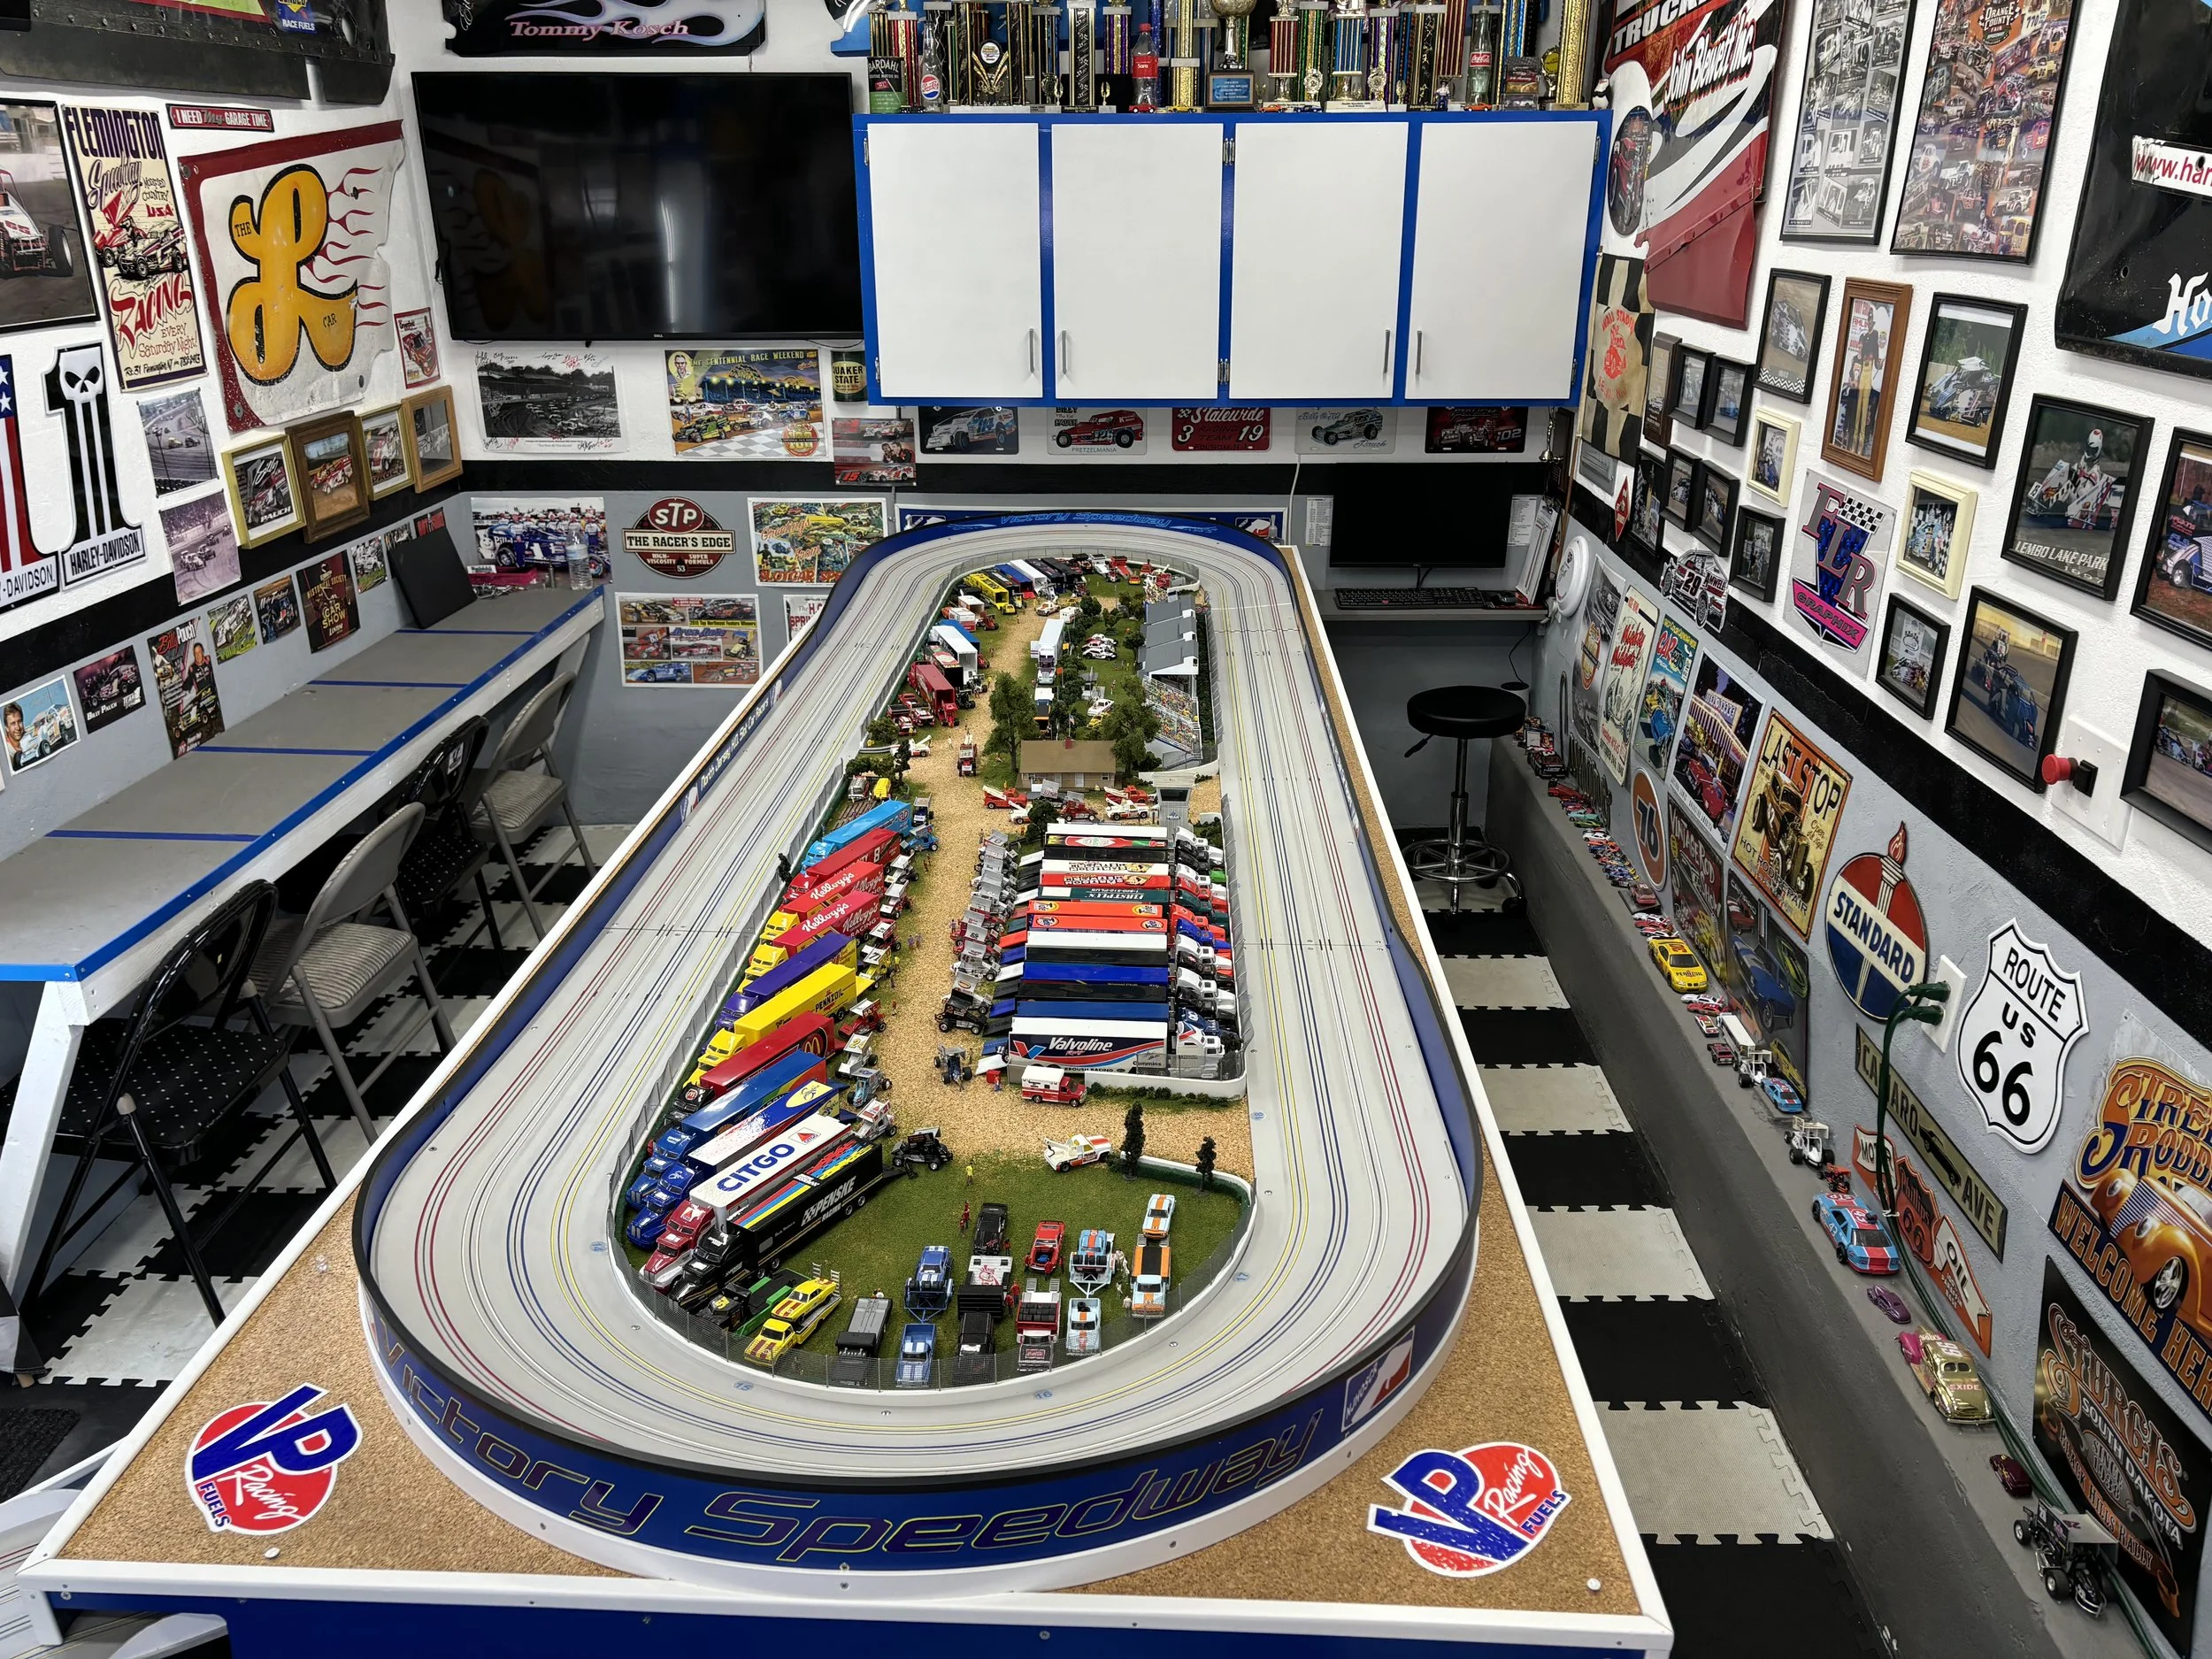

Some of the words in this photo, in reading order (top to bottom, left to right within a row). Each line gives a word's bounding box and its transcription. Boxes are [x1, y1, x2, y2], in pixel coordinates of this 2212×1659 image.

[1984, 15, 2011, 32] COUNTY
[1985, 1, 2016, 19] ORANGE
[282, 19, 299, 28] RACE
[298, 21, 315, 31] FUELS
[510, 20, 604, 42] Tommy
[608, 19, 689, 36] Kosch
[868, 58, 899, 73] BARDAHL
[1664, 47, 1694, 104] John
[176, 109, 180, 124] I
[181, 109, 203, 125] NEED
[224, 111, 250, 127] GARAGE
[250, 113, 269, 127] TIME
[142, 189, 168, 202] COUNTRY
[234, 222, 252, 237] THE
[110, 273, 193, 349] RACING
[322, 311, 337, 329] CAR
[138, 339, 177, 358] Saturday
[176, 330, 197, 355] Night!
[161, 322, 187, 338] EVERY
[705, 355, 748, 366] CENTENNIAL
[750, 352, 770, 362] RACE
[772, 350, 805, 361] WEEKEND
[834, 374, 860, 384] STATE
[1191, 407, 1265, 424] Statewide
[1178, 425, 1194, 442] 3
[1239, 424, 1264, 442] 19
[260, 506, 291, 524] PAUCH
[654, 502, 698, 528] STP
[1001, 512, 1071, 525] Victory
[1072, 511, 1172, 528] Speedway
[626, 536, 649, 547] THE
[652, 535, 699, 548] RACER'S
[701, 536, 731, 549] EDGE
[760, 519, 811, 541] Greetings
[70, 531, 141, 576] HARLEY-DAVIDSON
[795, 545, 821, 562] From
[1801, 481, 1878, 621] FLR
[2015, 541, 2048, 559] LEMBO
[2047, 547, 2076, 565] LAKE
[2076, 553, 2109, 571] PARK
[0, 564, 54, 598] -DAVIDSON
[676, 564, 687, 572] 53
[758, 569, 815, 584] SLOTCAR
[1682, 572, 1702, 597] 29
[321, 603, 342, 618] CAR
[321, 609, 346, 629] SHOW
[1796, 591, 1861, 641] GRAPHIX
[1761, 724, 1803, 782] LAST
[1794, 757, 1842, 822] STOP
[1636, 802, 1659, 858] 76
[873, 848, 880, 864] 8
[1740, 835, 1758, 860] HOT
[810, 872, 856, 900] Kellogg's
[801, 902, 850, 933] Kellogg's
[842, 902, 879, 933] Kellogg's
[849, 918, 877, 938] RACING
[1832, 890, 1916, 984] STANDARD
[2003, 946, 2066, 1022] ROUTE
[814, 988, 844, 1013] PENNZOIL
[1048, 1037, 1113, 1052] Valvoline
[1972, 1030, 2034, 1127] 66
[1861, 1041, 1919, 1139] CAARO
[1962, 1174, 1996, 1238] AVE
[716, 1143, 796, 1193] CITGO
[812, 1176, 857, 1219] PENSKE
[1828, 1222, 1839, 1238] 43
[1902, 1206, 1924, 1254] 66
[1947, 1240, 1970, 1303] OIL
[2055, 1191, 2164, 1344] WELCOME
[2160, 1317, 2212, 1417] HER
[2041, 1302, 2198, 1535] STURGIS
[191, 1383, 359, 1483] VP
[372, 1316, 664, 1536] Victory
[684, 1409, 1325, 1563] Speedway
[2081, 1395, 2124, 1460] SOUTH
[2124, 1455, 2184, 1550] DAKOTA
[2092, 1439, 2124, 1484] SINCE
[216, 1463, 306, 1520] Racing
[1482, 1448, 1538, 1518] Racing
[2093, 1455, 2122, 1502] 1938
[198, 1482, 232, 1528] FUELS
[1371, 1449, 1532, 1563] VP
[2058, 1421, 2086, 1493] BLACK
[2088, 1475, 2117, 1535] HILLS
[2117, 1526, 2154, 1571] RALLY
[1520, 1488, 1568, 1538] FUELS
